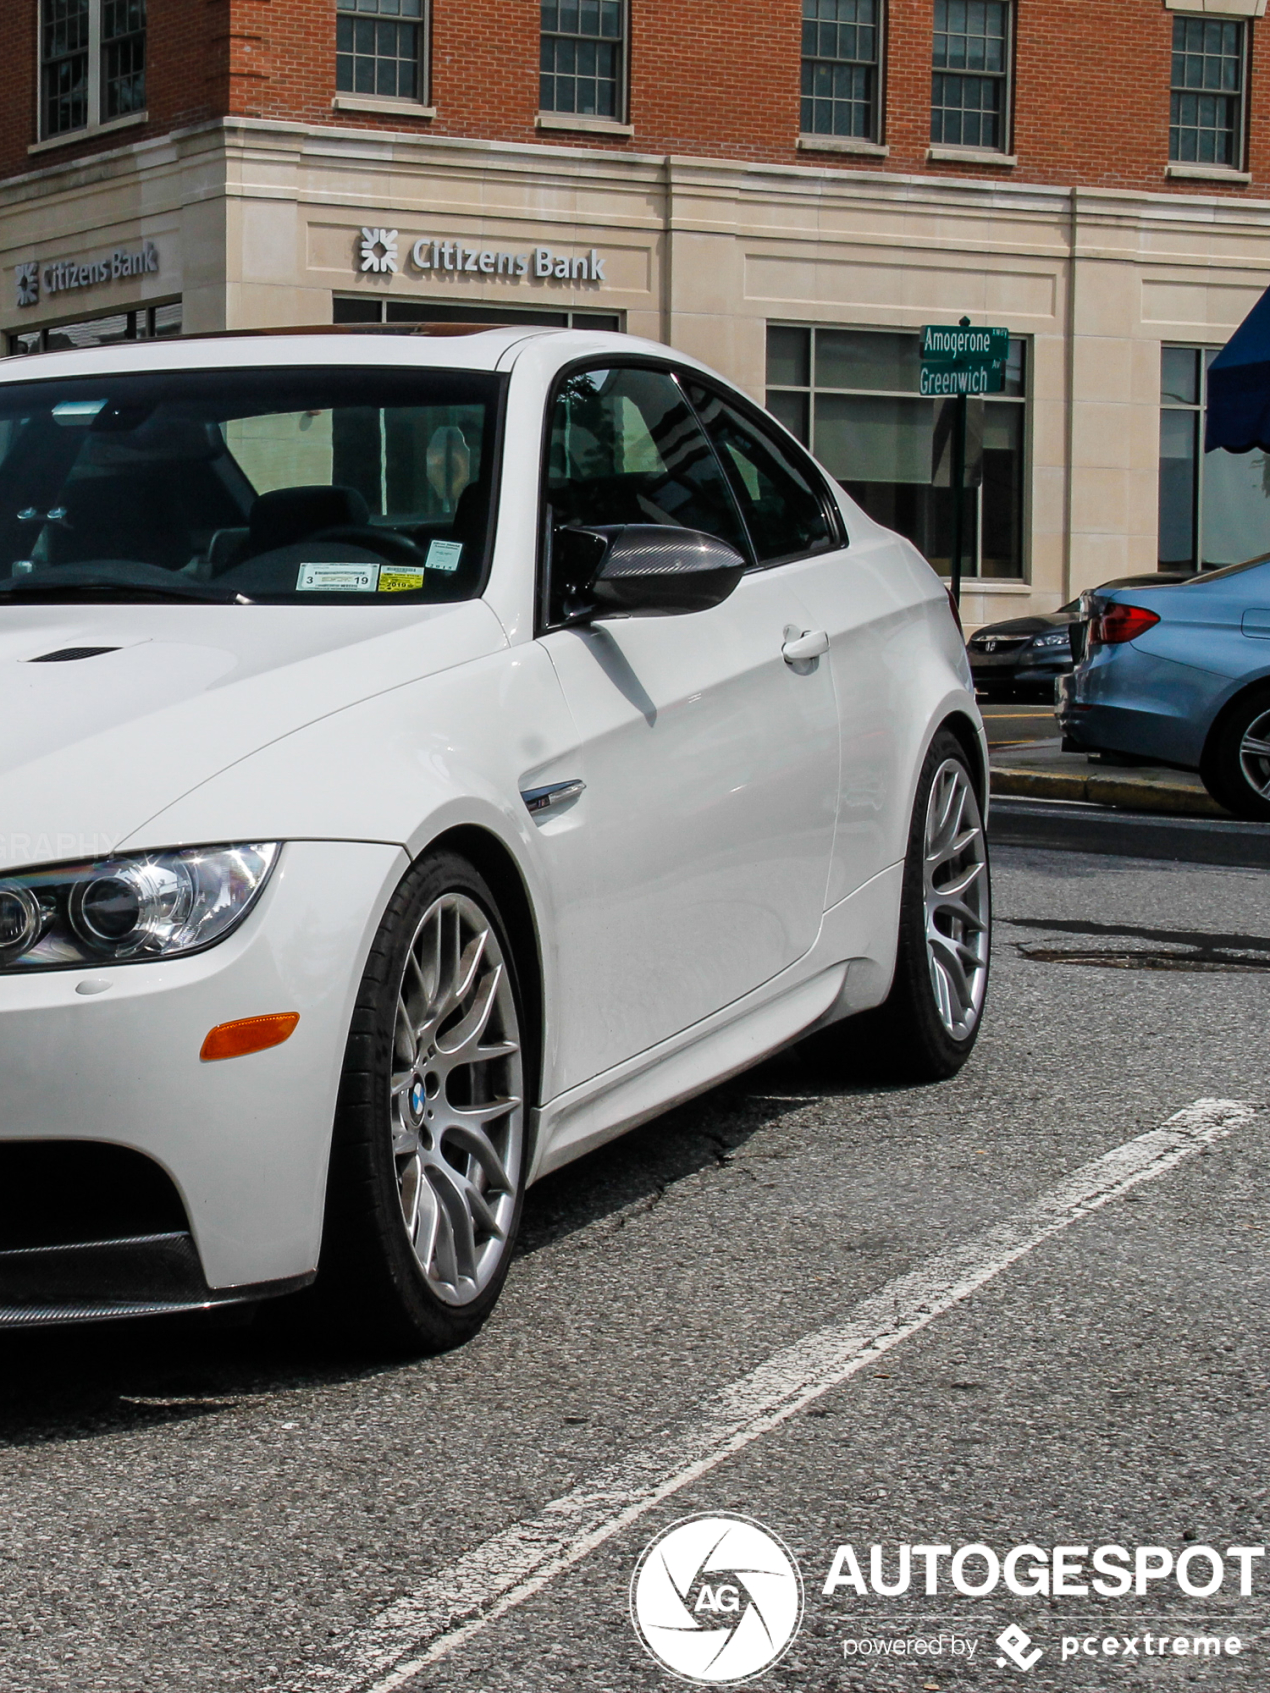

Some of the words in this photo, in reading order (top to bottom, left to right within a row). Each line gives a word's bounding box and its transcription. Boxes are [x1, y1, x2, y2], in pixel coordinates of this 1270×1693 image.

[42, 259, 110, 293] Citizens
[111, 242, 158, 279] Bank
[413, 238, 528, 276] Citizens
[535, 248, 606, 280] Bank
[924, 327, 990, 359] Amogerone
[920, 366, 988, 394] Greenwich
[306, 576, 314, 584] 3
[354, 576, 369, 585] 19
